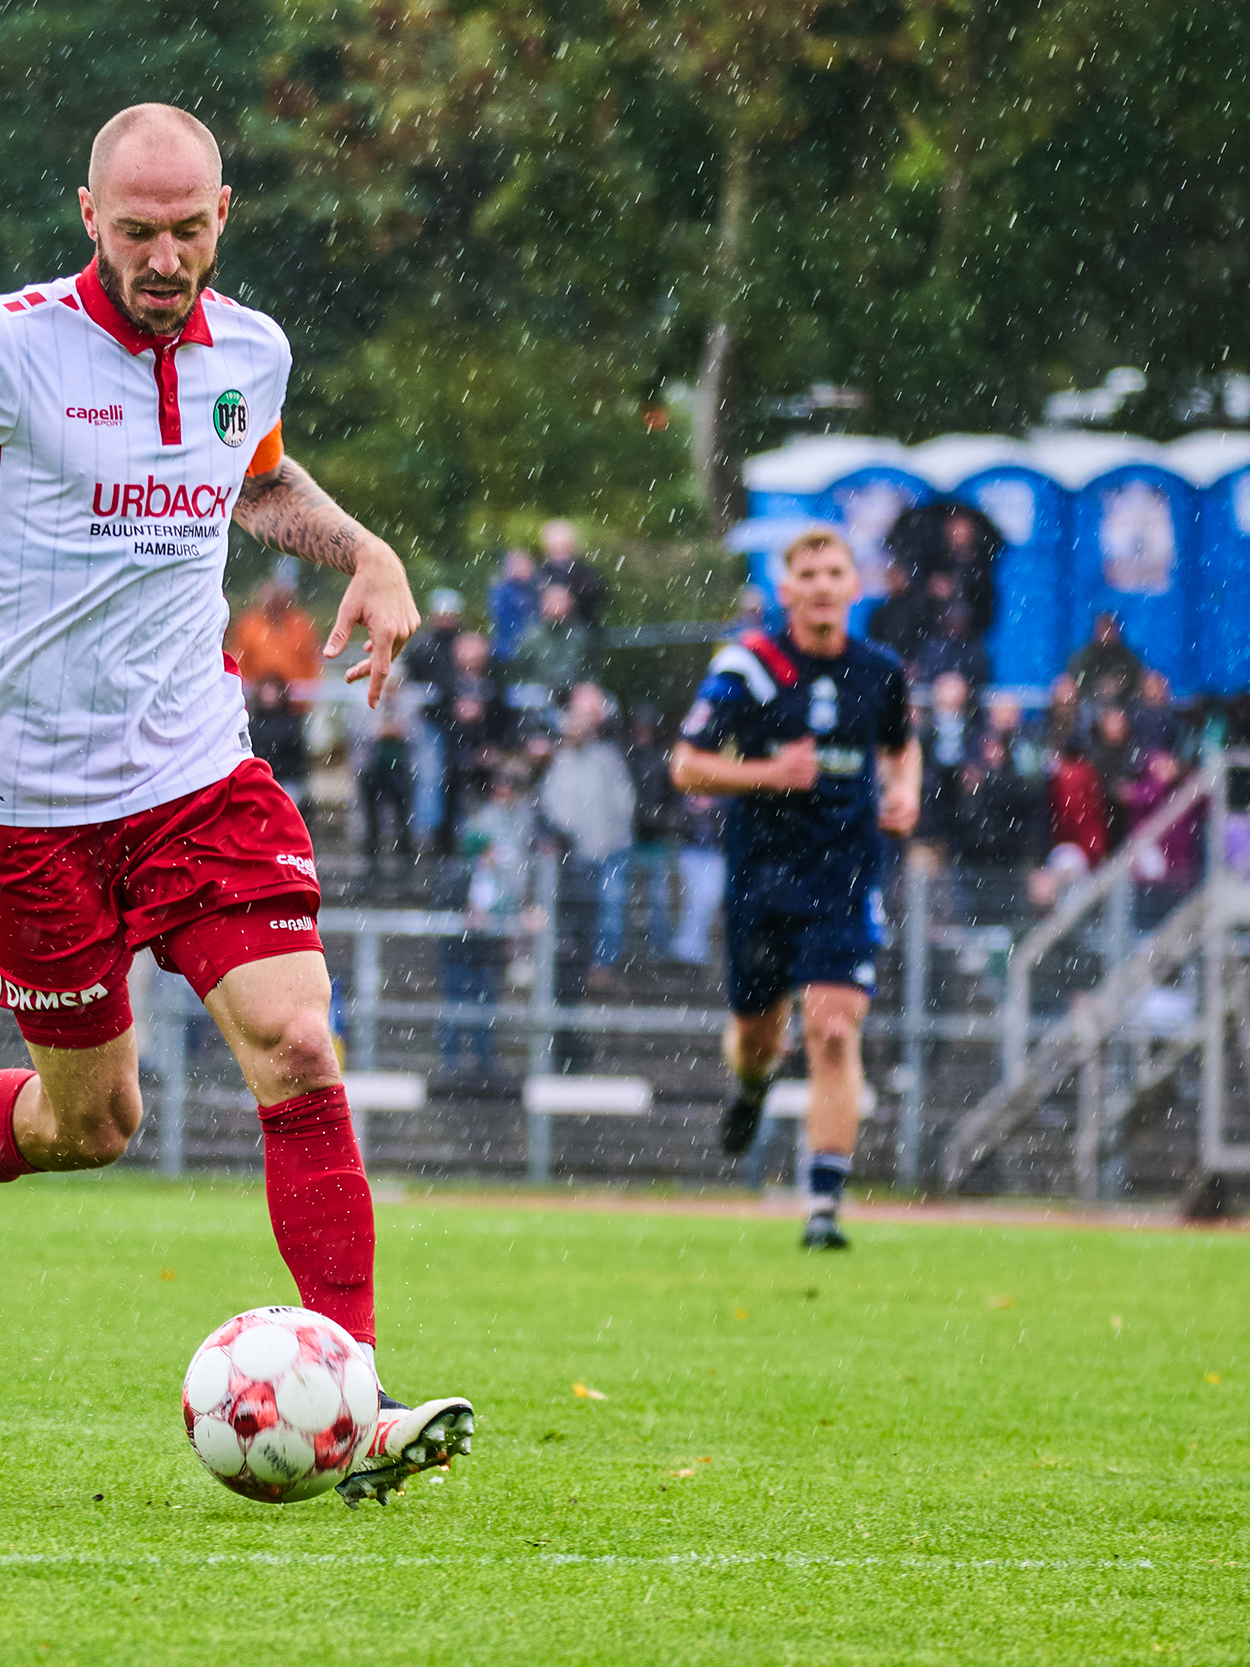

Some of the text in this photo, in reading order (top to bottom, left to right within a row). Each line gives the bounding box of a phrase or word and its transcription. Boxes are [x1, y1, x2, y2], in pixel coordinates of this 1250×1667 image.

[65, 404, 123, 424] capelli
[90, 523, 220, 538] BAUUNTERNEHMUNG
[134, 541, 200, 556] HAMBURG
[270, 915, 313, 931] capelli
